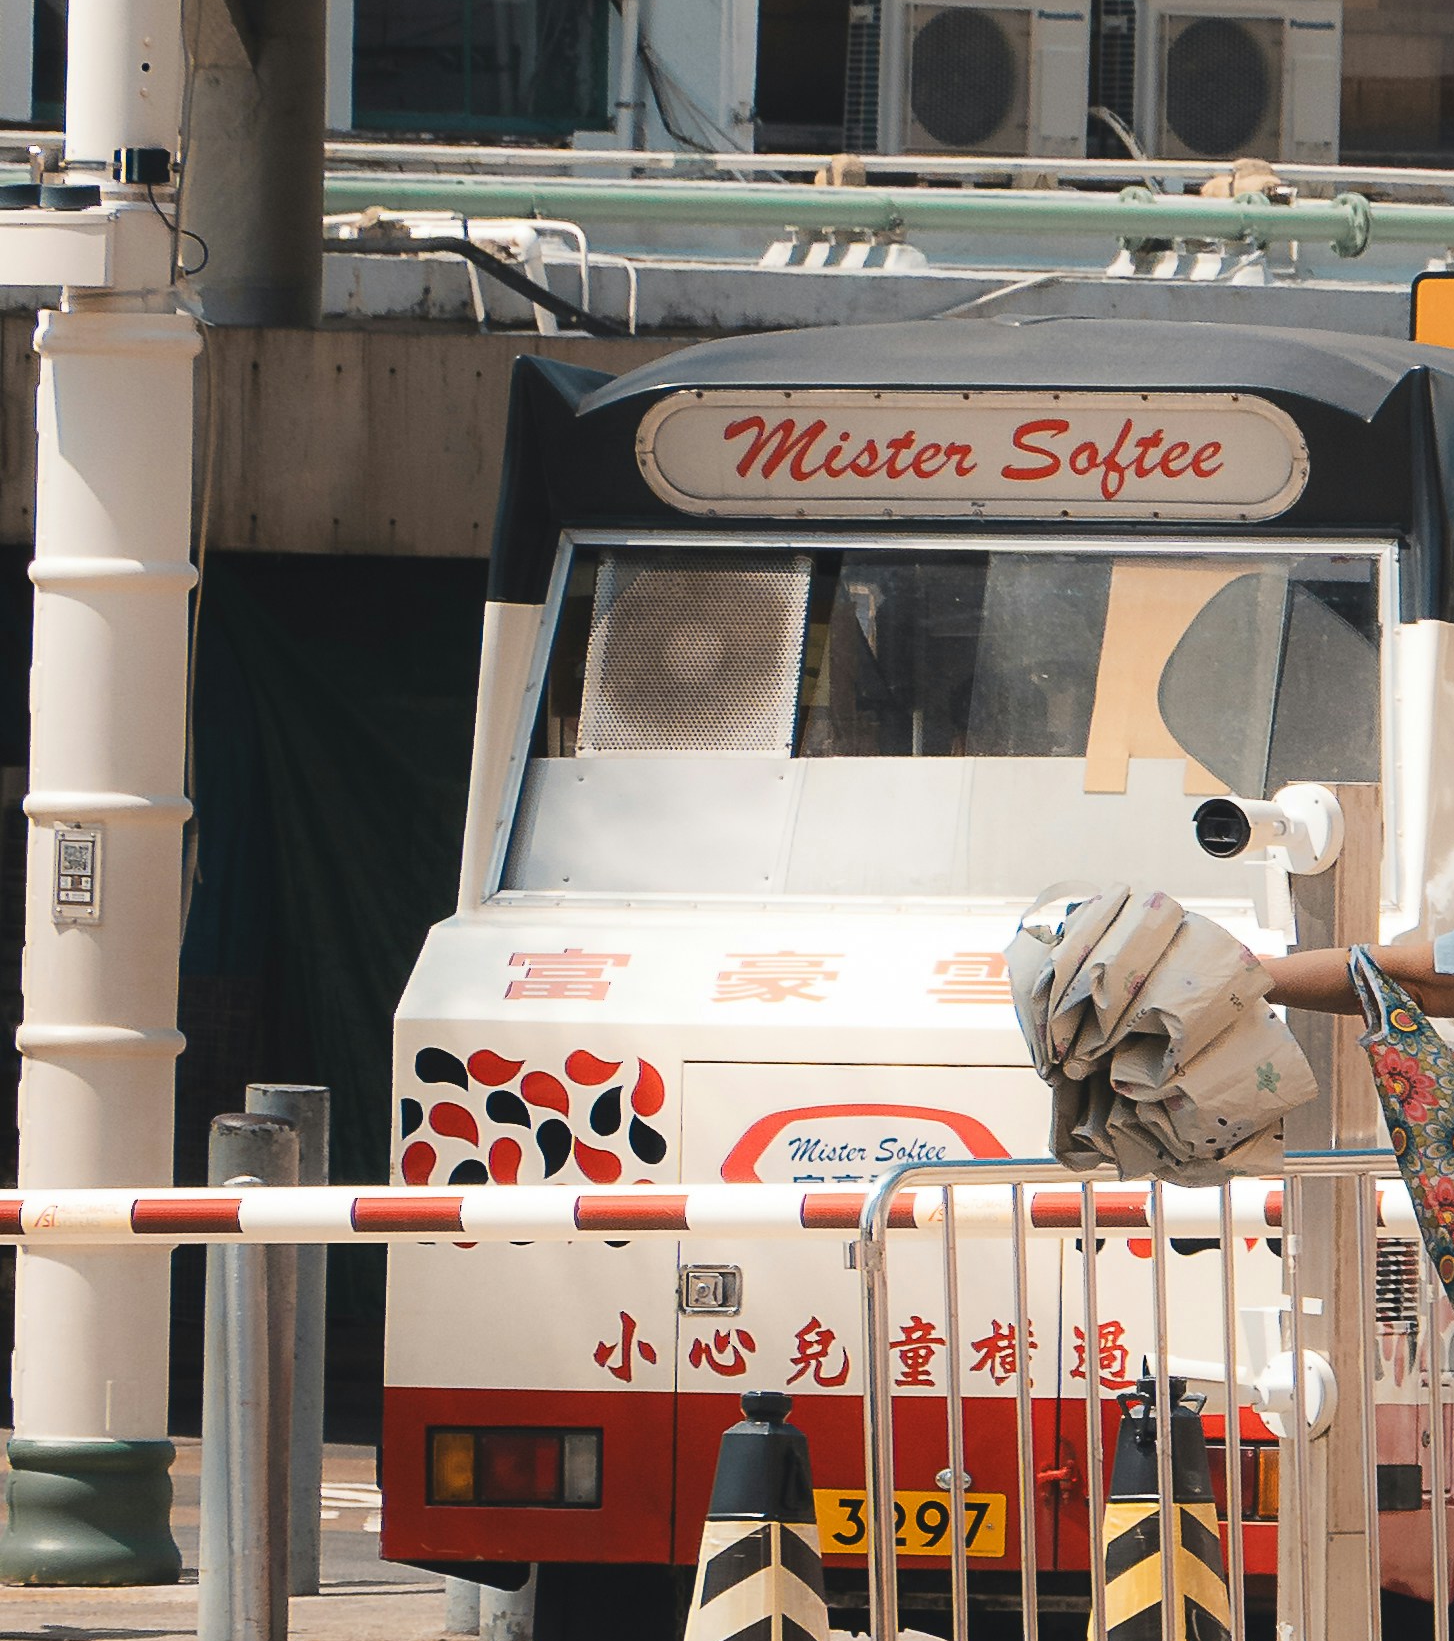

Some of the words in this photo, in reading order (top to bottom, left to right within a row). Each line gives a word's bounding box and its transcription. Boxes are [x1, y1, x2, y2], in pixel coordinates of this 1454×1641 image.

[724, 415, 978, 481] Mister
[1000, 417, 1224, 501] Softee
[788, 1137, 867, 1162] Mister
[875, 1137, 946, 1161] Softee
